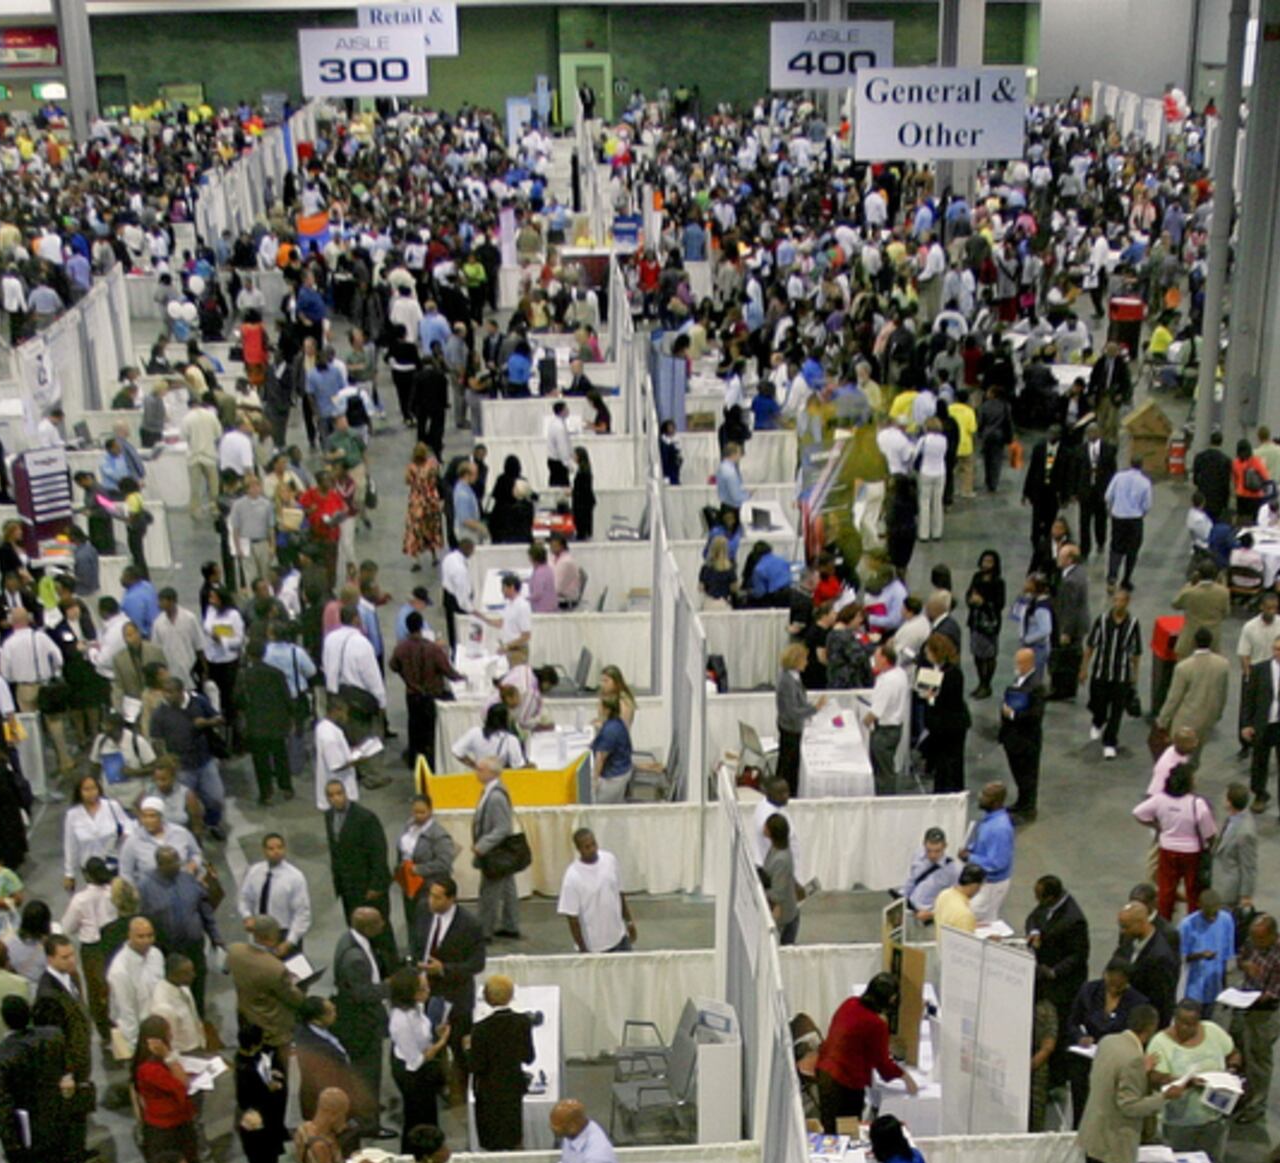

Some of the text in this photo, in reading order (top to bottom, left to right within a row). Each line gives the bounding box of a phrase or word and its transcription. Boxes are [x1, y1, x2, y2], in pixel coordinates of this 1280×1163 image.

[370, 8, 444, 25] Retail &
[335, 35, 390, 51] AISLE
[805, 28, 861, 45] AISLE
[318, 57, 410, 84] 300
[787, 51, 878, 76] 400
[864, 76, 1017, 104] General &
[897, 121, 985, 148] Other
